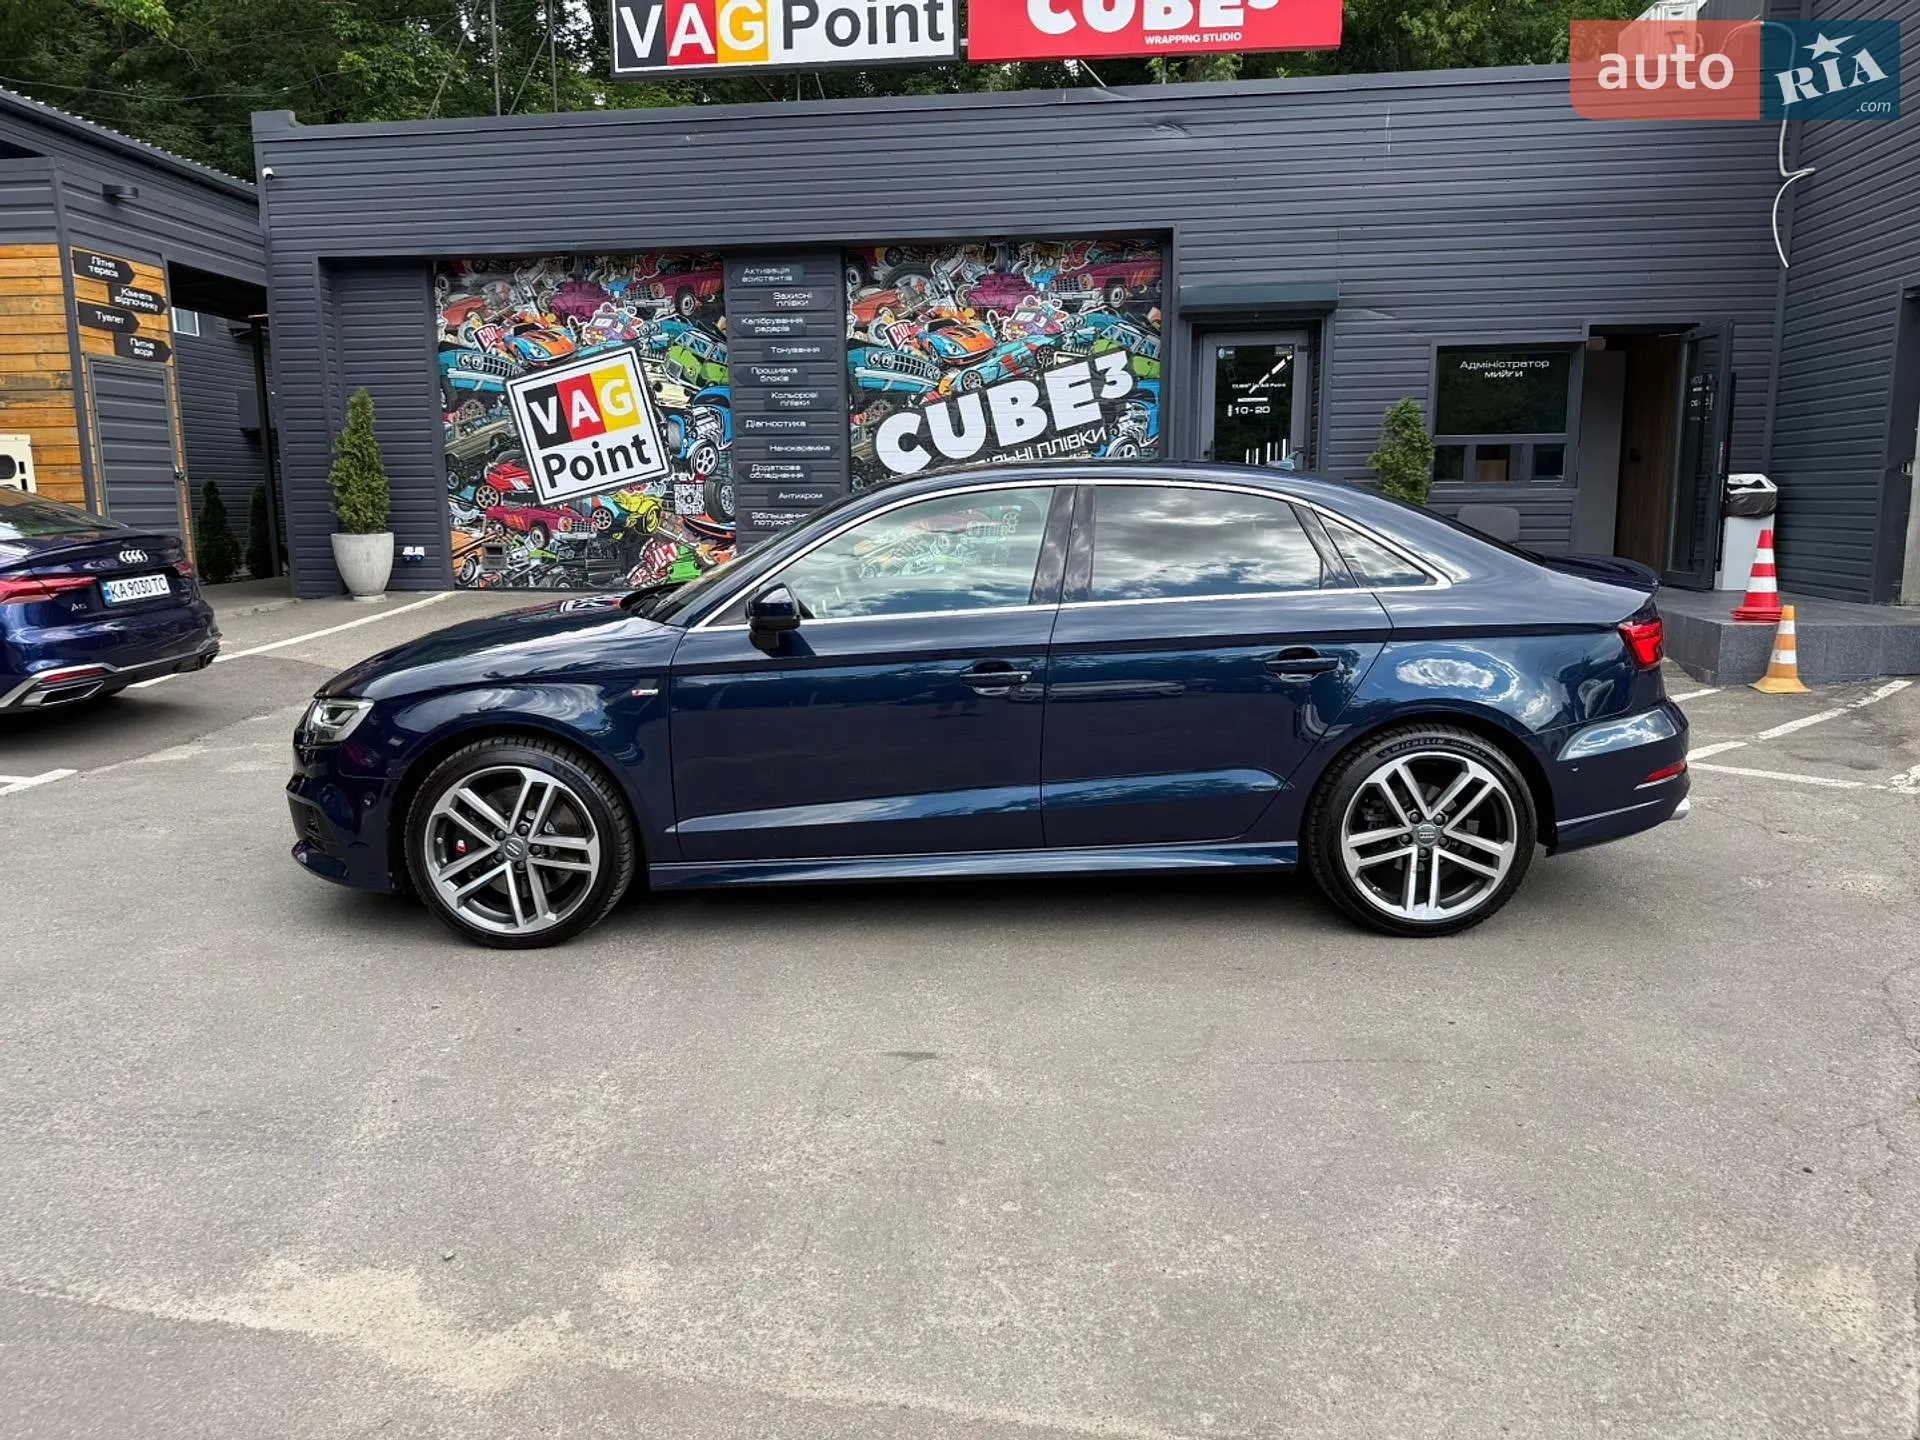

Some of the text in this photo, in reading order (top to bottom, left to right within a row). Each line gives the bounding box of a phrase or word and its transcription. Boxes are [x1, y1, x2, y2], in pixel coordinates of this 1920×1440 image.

[619, 0, 945, 59] VAG Point
[1144, 32, 1242, 45] WRAPPING STUDIO
[95, 311, 125, 324] Туалет
[770, 346, 820, 355] Тонування
[751, 366, 798, 375] Прошивка
[1459, 360, 1550, 370] Адміністратор
[528, 378, 634, 435] VAG
[745, 419, 807, 428] Діагностика
[1037, 427, 1107, 459] ПЛІВКИ
[542, 433, 652, 489] Point
[778, 492, 823, 500] Антихром
